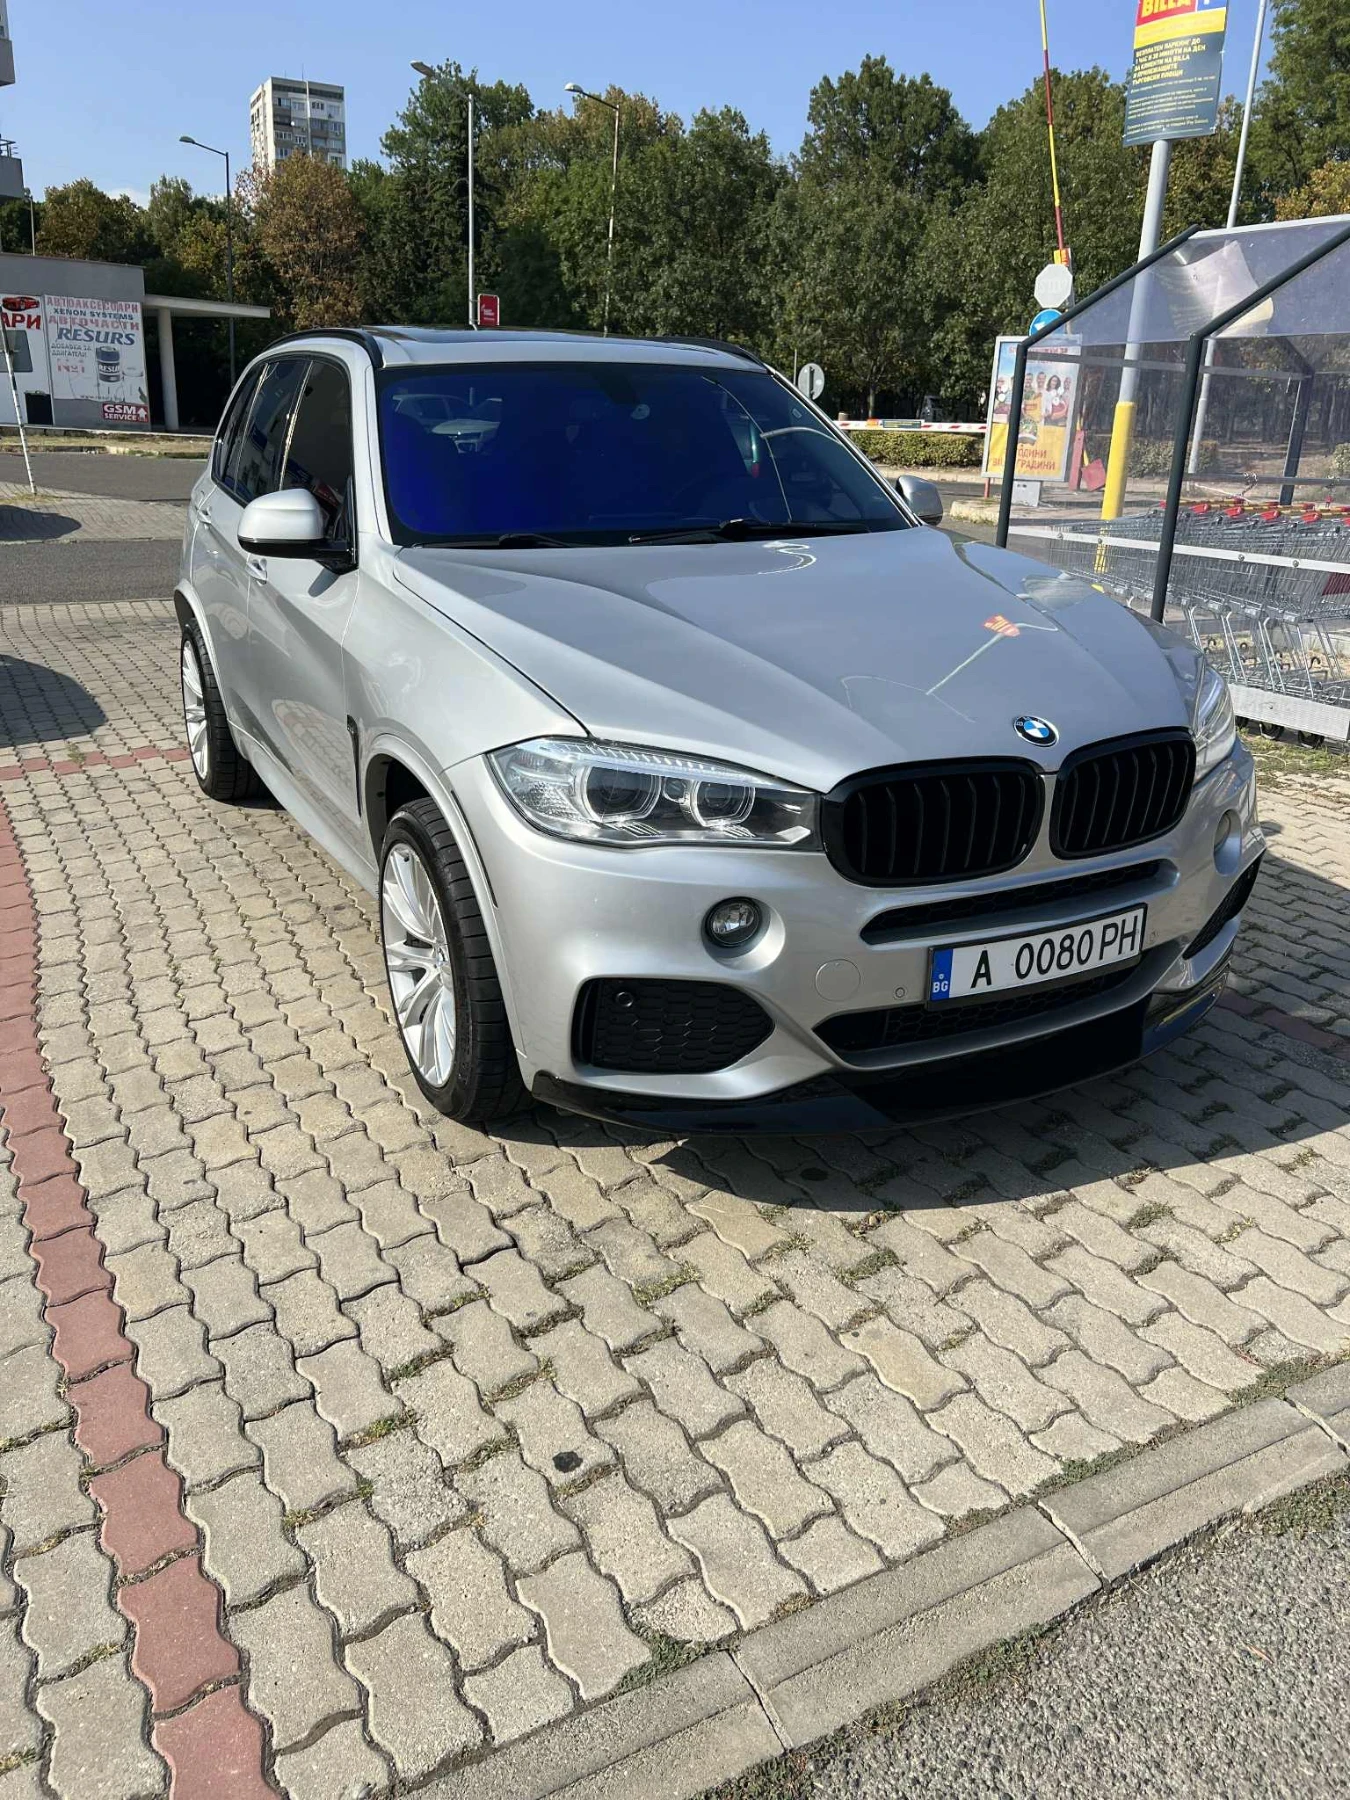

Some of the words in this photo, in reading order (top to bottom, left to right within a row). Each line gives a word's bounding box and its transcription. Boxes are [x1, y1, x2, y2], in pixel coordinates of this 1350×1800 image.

[47, 297, 138, 313] АВТОАКСЕСОАРИ
[53, 308, 87, 316] XENON
[90, 311, 134, 320] SYSTEMS
[48, 315, 139, 331] АВТОЧАСТИ
[57, 327, 135, 346] RESURS
[104, 404, 136, 414] GSM
[970, 950, 992, 988] A
[1015, 929, 1094, 979] 0080
[1099, 915, 1139, 960] PH
[932, 980, 948, 993] BG
